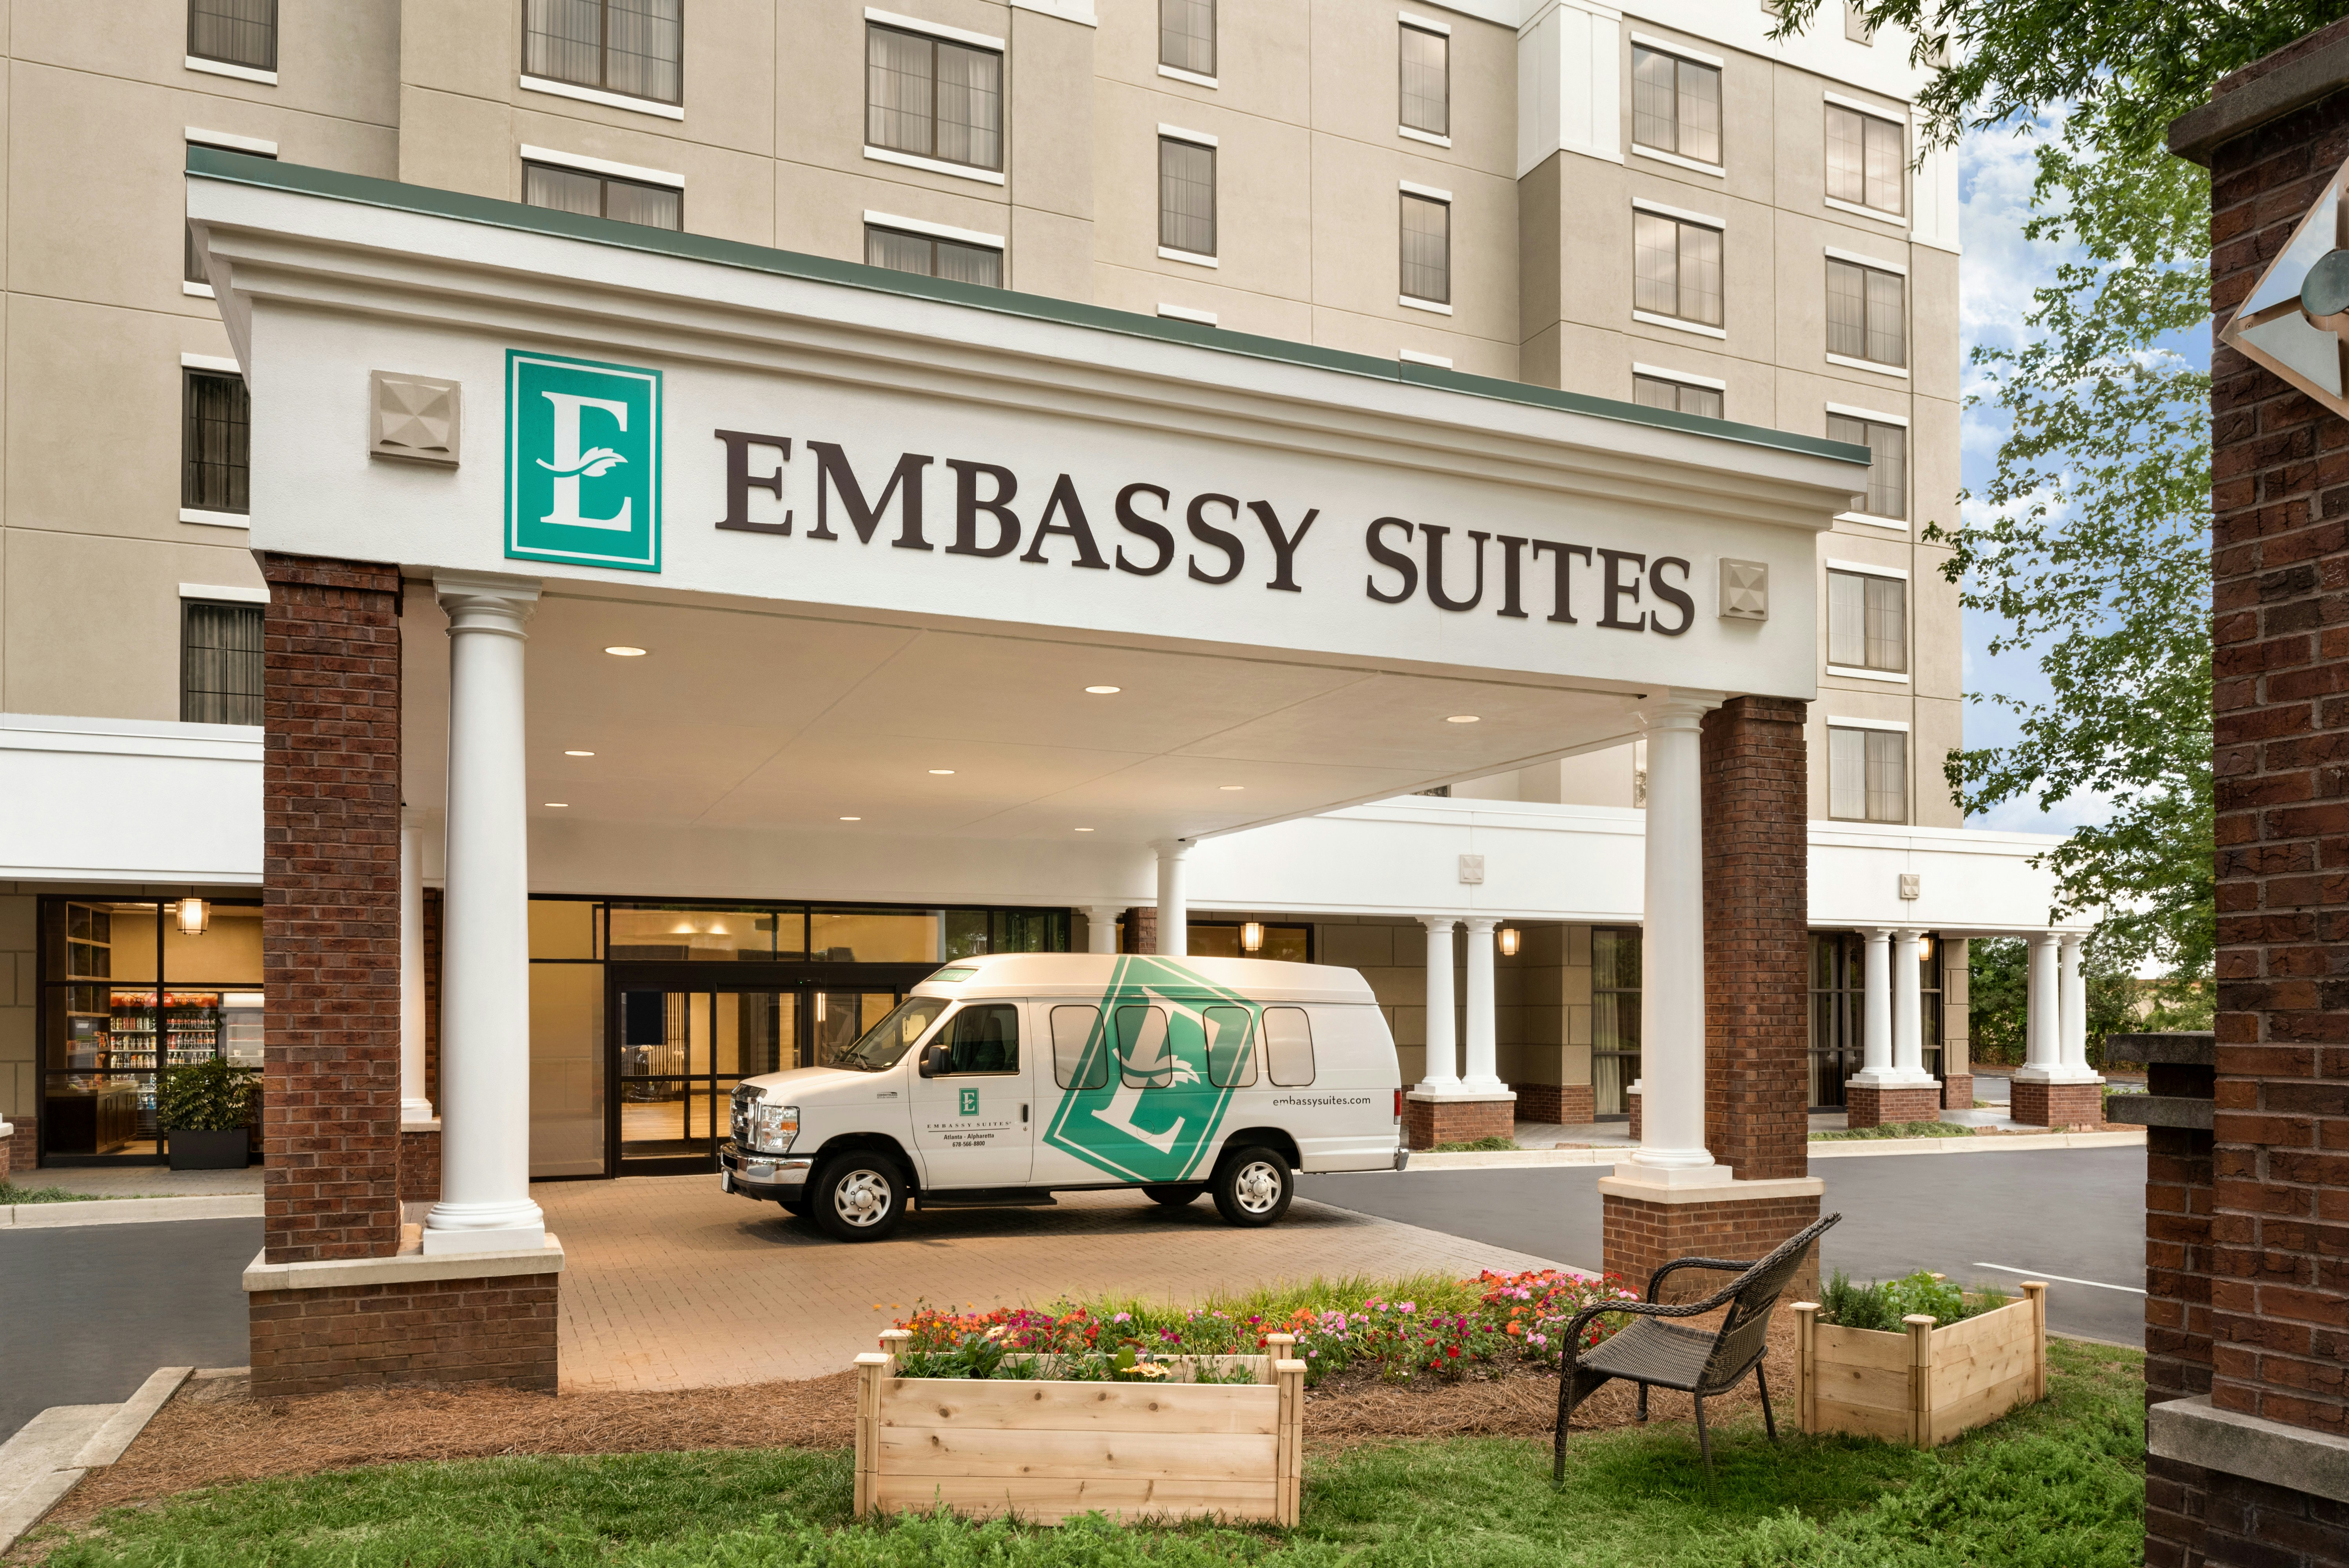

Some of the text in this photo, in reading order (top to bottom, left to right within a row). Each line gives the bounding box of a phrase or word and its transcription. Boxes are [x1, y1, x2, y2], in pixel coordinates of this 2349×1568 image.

[714, 429, 1695, 636] EMBASSY SUITES
[1273, 1095, 1371, 1107] embassysuites.com
